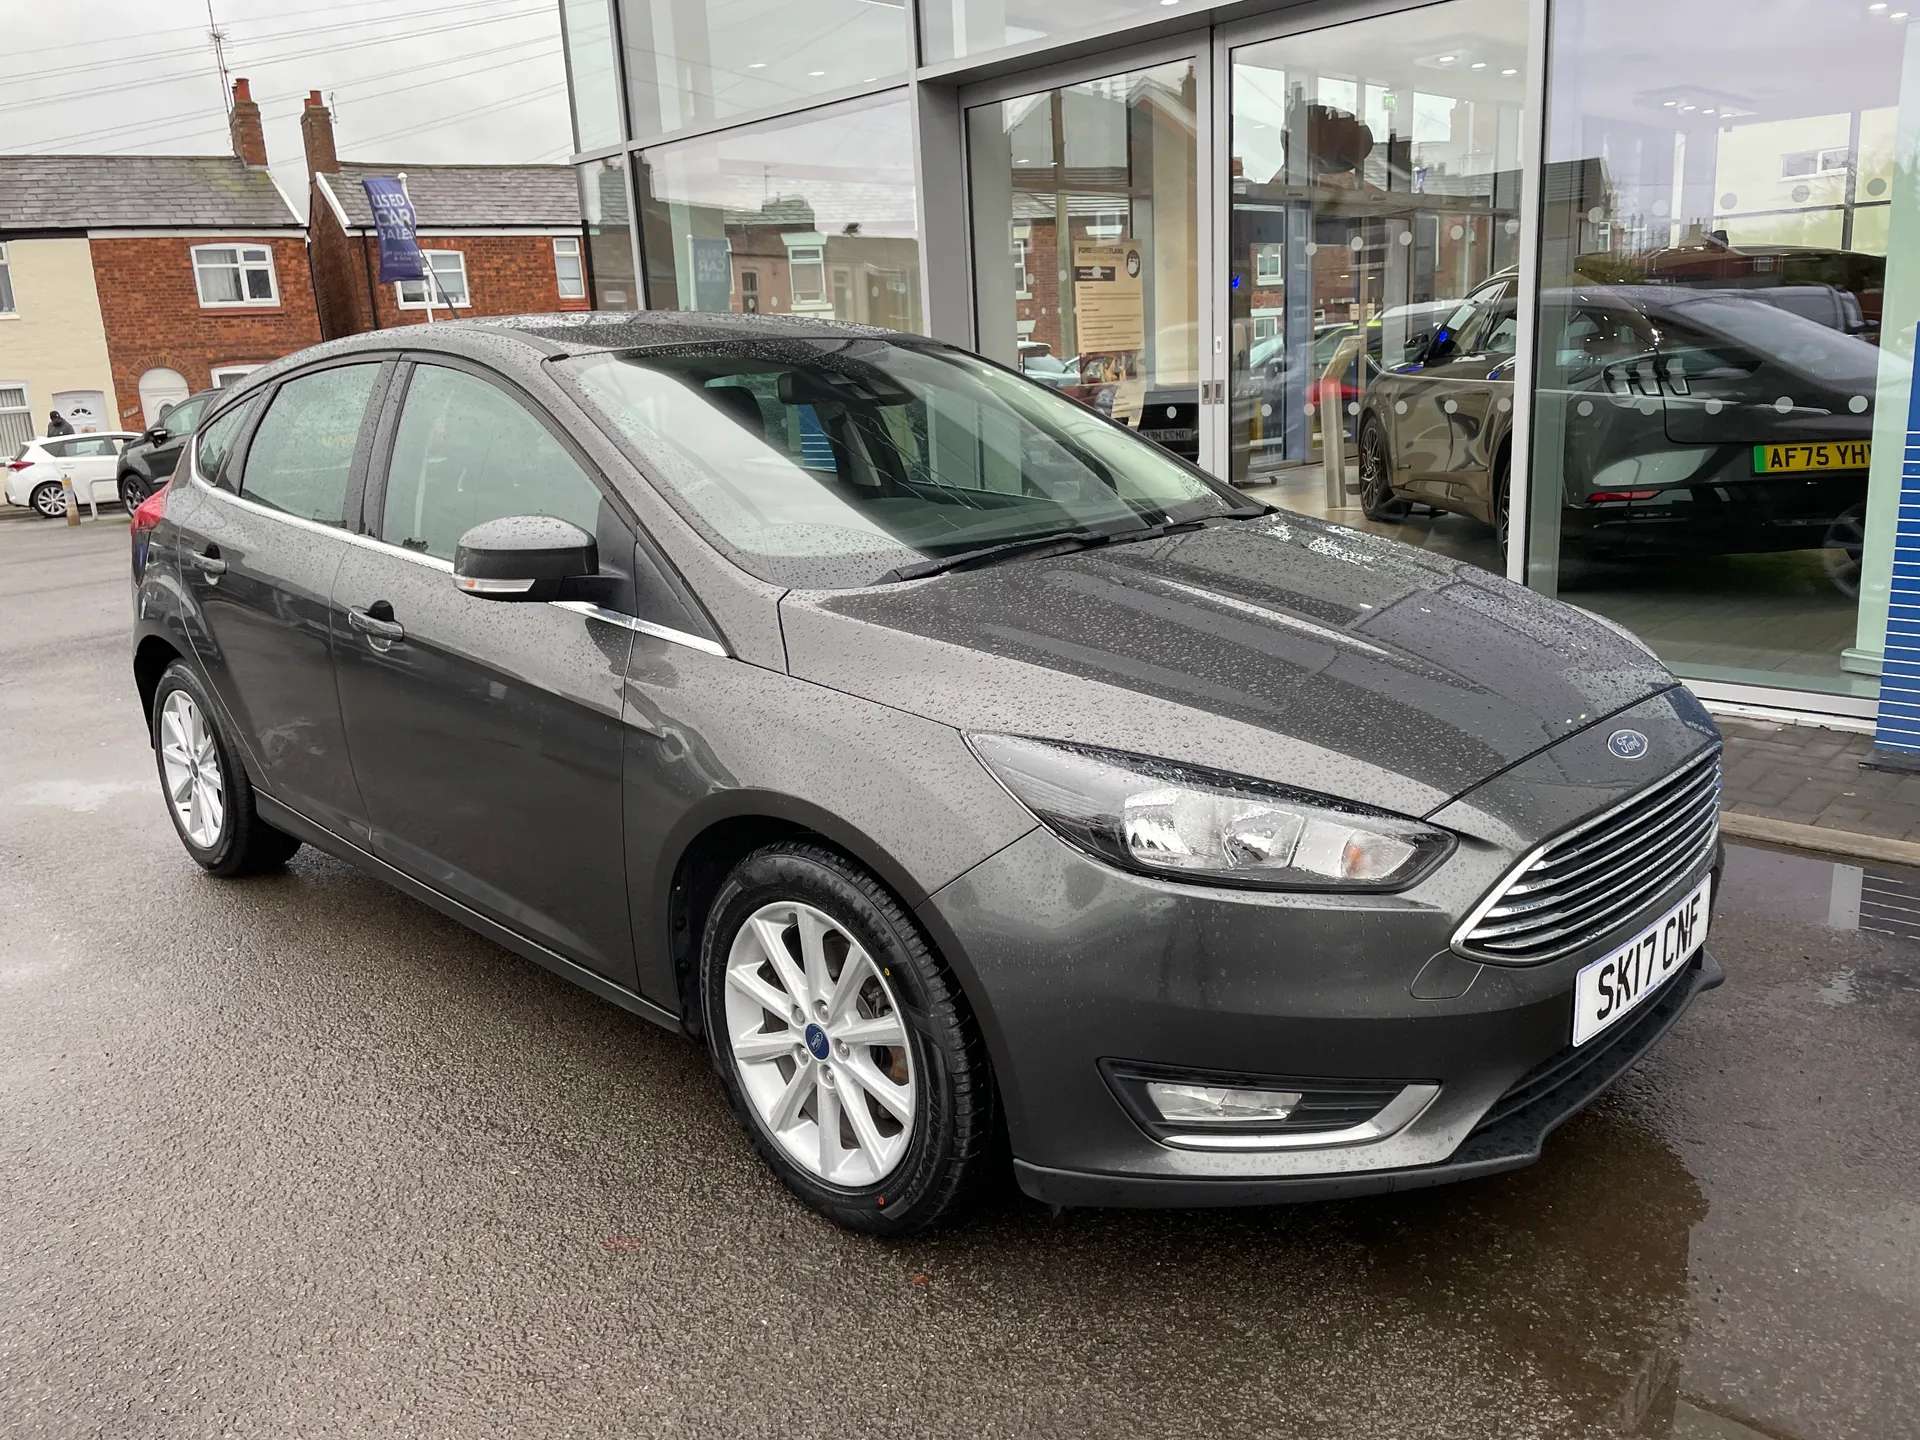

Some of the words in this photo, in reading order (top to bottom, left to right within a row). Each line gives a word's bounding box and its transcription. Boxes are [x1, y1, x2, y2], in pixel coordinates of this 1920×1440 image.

[371, 193, 405, 208] USED
[375, 208, 412, 227] CAR
[1770, 446, 1829, 468] AF75
[1596, 931, 1658, 1021] SK17
[1662, 892, 1701, 970] CNF
